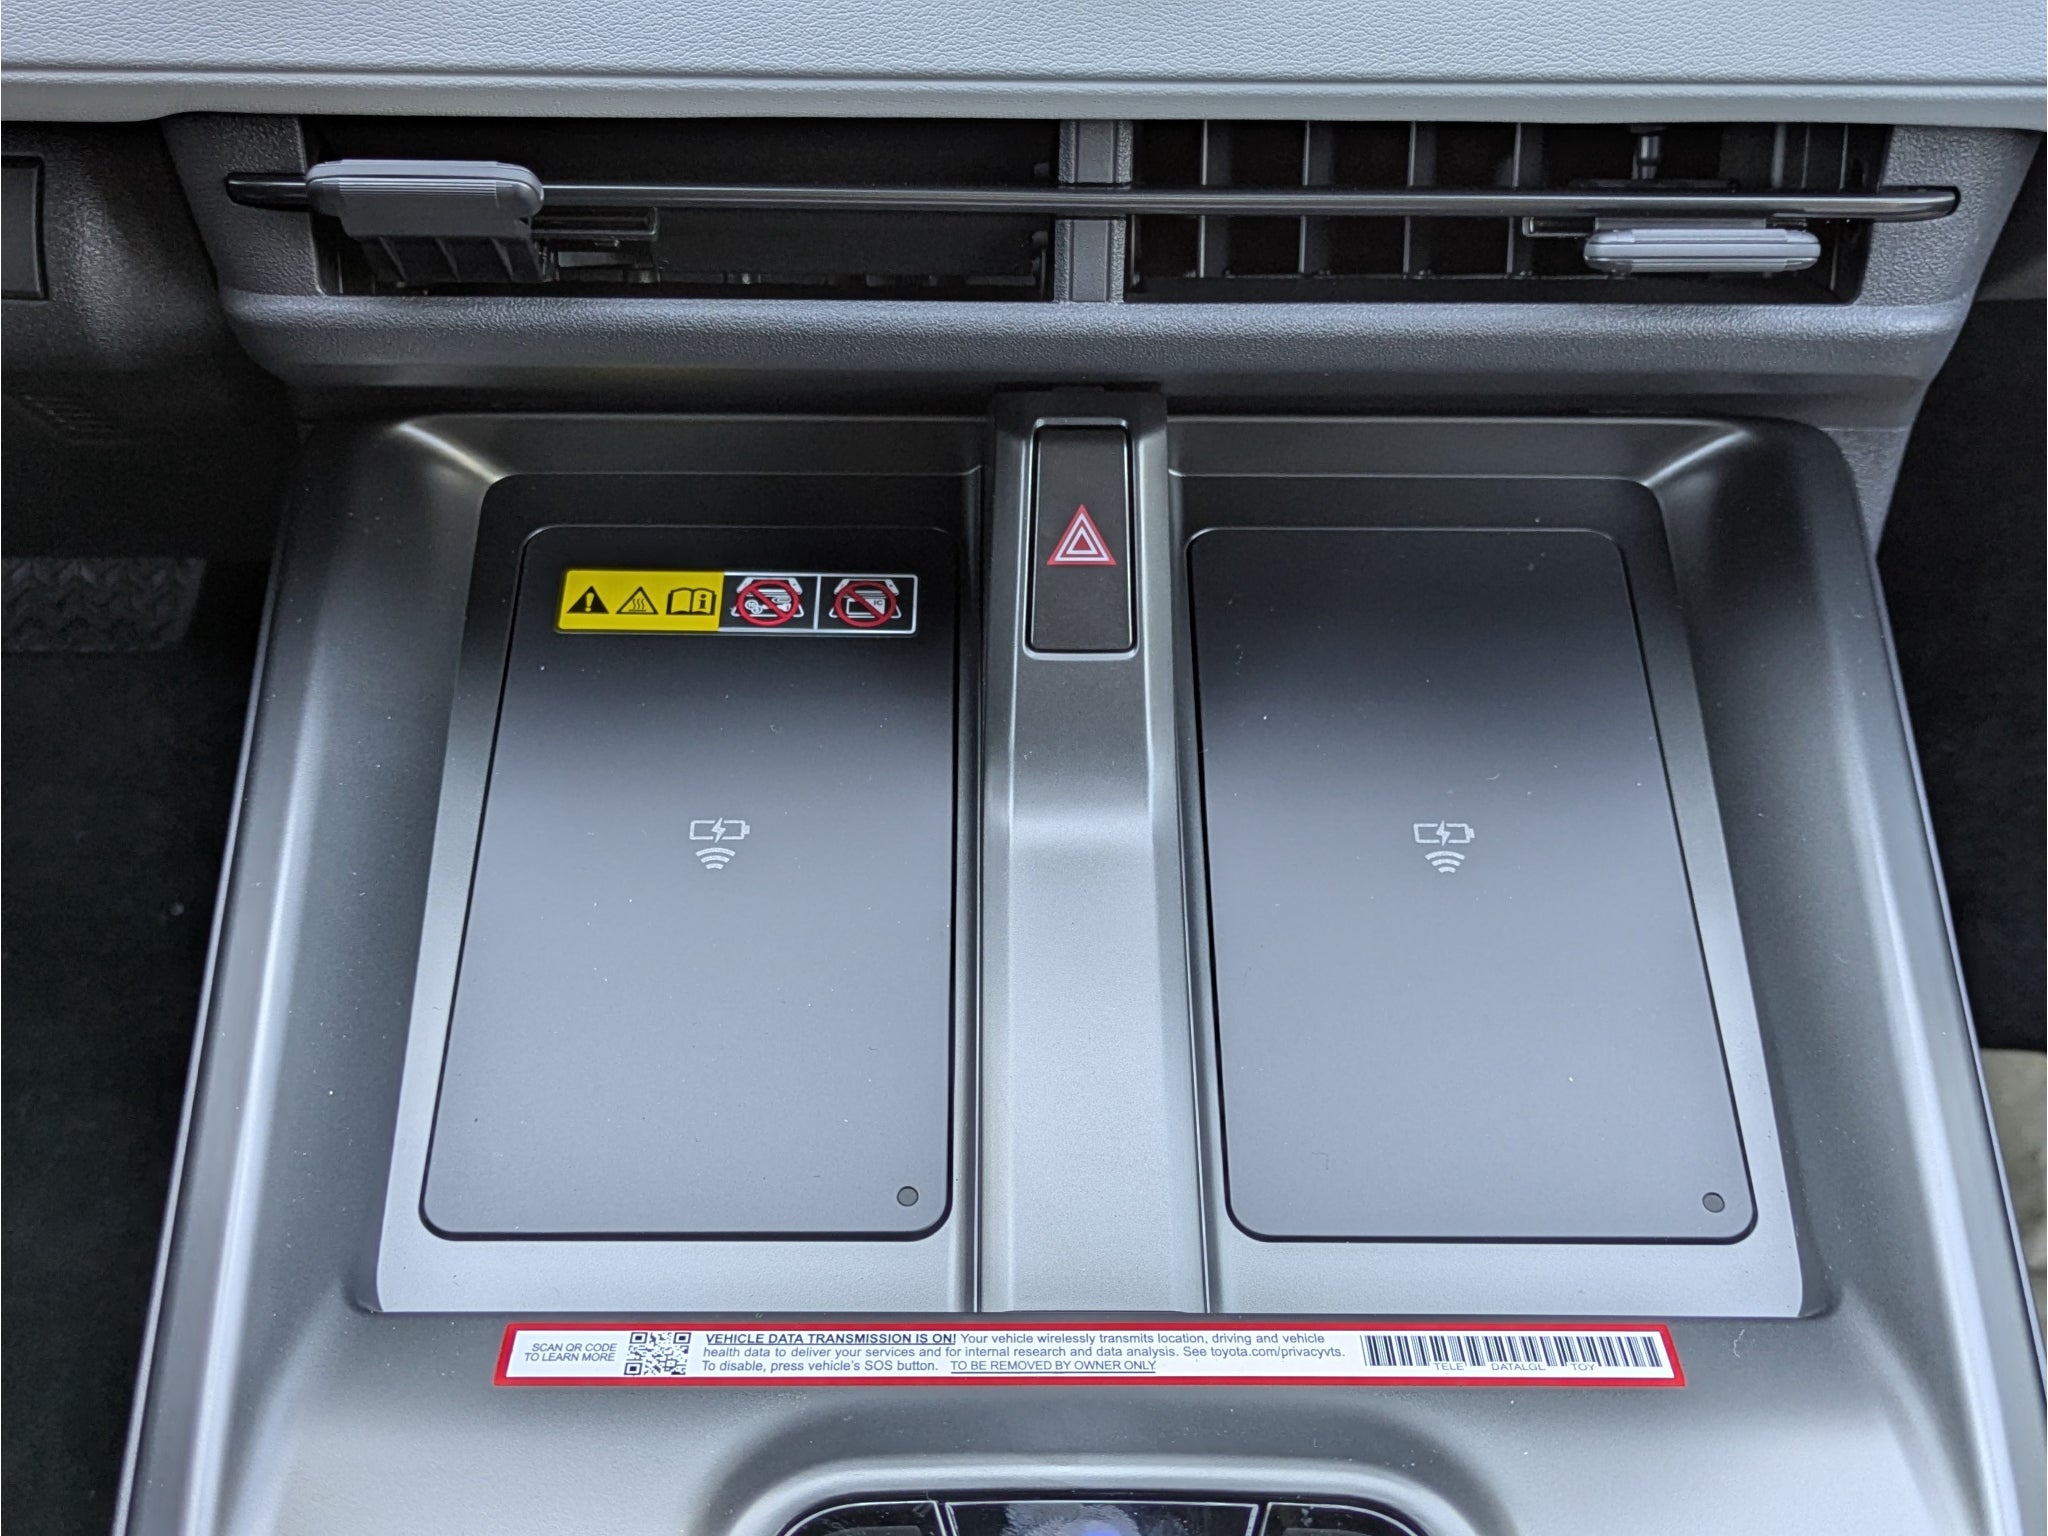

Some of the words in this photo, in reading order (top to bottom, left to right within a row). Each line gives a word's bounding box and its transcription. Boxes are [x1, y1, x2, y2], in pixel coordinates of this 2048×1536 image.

[705, 1333, 764, 1344] VEHICLE
[768, 1333, 804, 1344] DATA
[808, 1333, 912, 1344] TRANSMISSION
[915, 1333, 928, 1344] IS
[932, 1333, 956, 1344] ON!
[961, 1333, 988, 1344] Your
[991, 1333, 1034, 1344] vehicle
[1037, 1333, 1095, 1346] wirelessly
[1099, 1333, 1154, 1344] transmits
[1157, 1333, 1208, 1345] location,
[1212, 1333, 1252, 1346] driving
[1256, 1333, 1279, 1344] and
[1282, 1333, 1325, 1344] vehicle
[532, 1343, 563, 1352] SCAN
[566, 1343, 582, 1352] QR
[585, 1343, 618, 1352] CODE
[703, 1347, 741, 1357] health
[744, 1347, 771, 1357] data
[774, 1347, 787, 1357] to
[791, 1347, 831, 1357] deliver
[835, 1349, 861, 1360] your
[865, 1347, 915, 1357] services
[919, 1347, 942, 1357] and
[945, 1347, 962, 1357] for
[965, 1347, 1010, 1357] internal
[1013, 1347, 1066, 1357] research
[1070, 1347, 1093, 1357] and
[1096, 1347, 1123, 1357] data
[1126, 1346, 1179, 1359] analysis.
[1183, 1347, 1207, 1357] See
[1211, 1346, 1346, 1359] toyota.com/privacyvts.
[524, 1352, 539, 1362] TO
[541, 1352, 581, 1362] LEARN
[581, 1352, 616, 1362] MORE
[702, 1360, 716, 1371] To
[719, 1360, 767, 1373] disable,
[770, 1362, 805, 1374] press
[808, 1360, 861, 1371] vehicle's
[864, 1360, 894, 1371] SOS
[896, 1360, 939, 1371] button.
[950, 1361, 968, 1371] TO
[970, 1361, 987, 1371] BE
[990, 1361, 1052, 1371] REMOVED
[1055, 1361, 1072, 1371] BY
[1074, 1361, 1122, 1371] OWNER
[1124, 1361, 1156, 1371] ONLY
[1435, 1362, 1465, 1371] TELE
[1571, 1362, 1596, 1371] TOY
